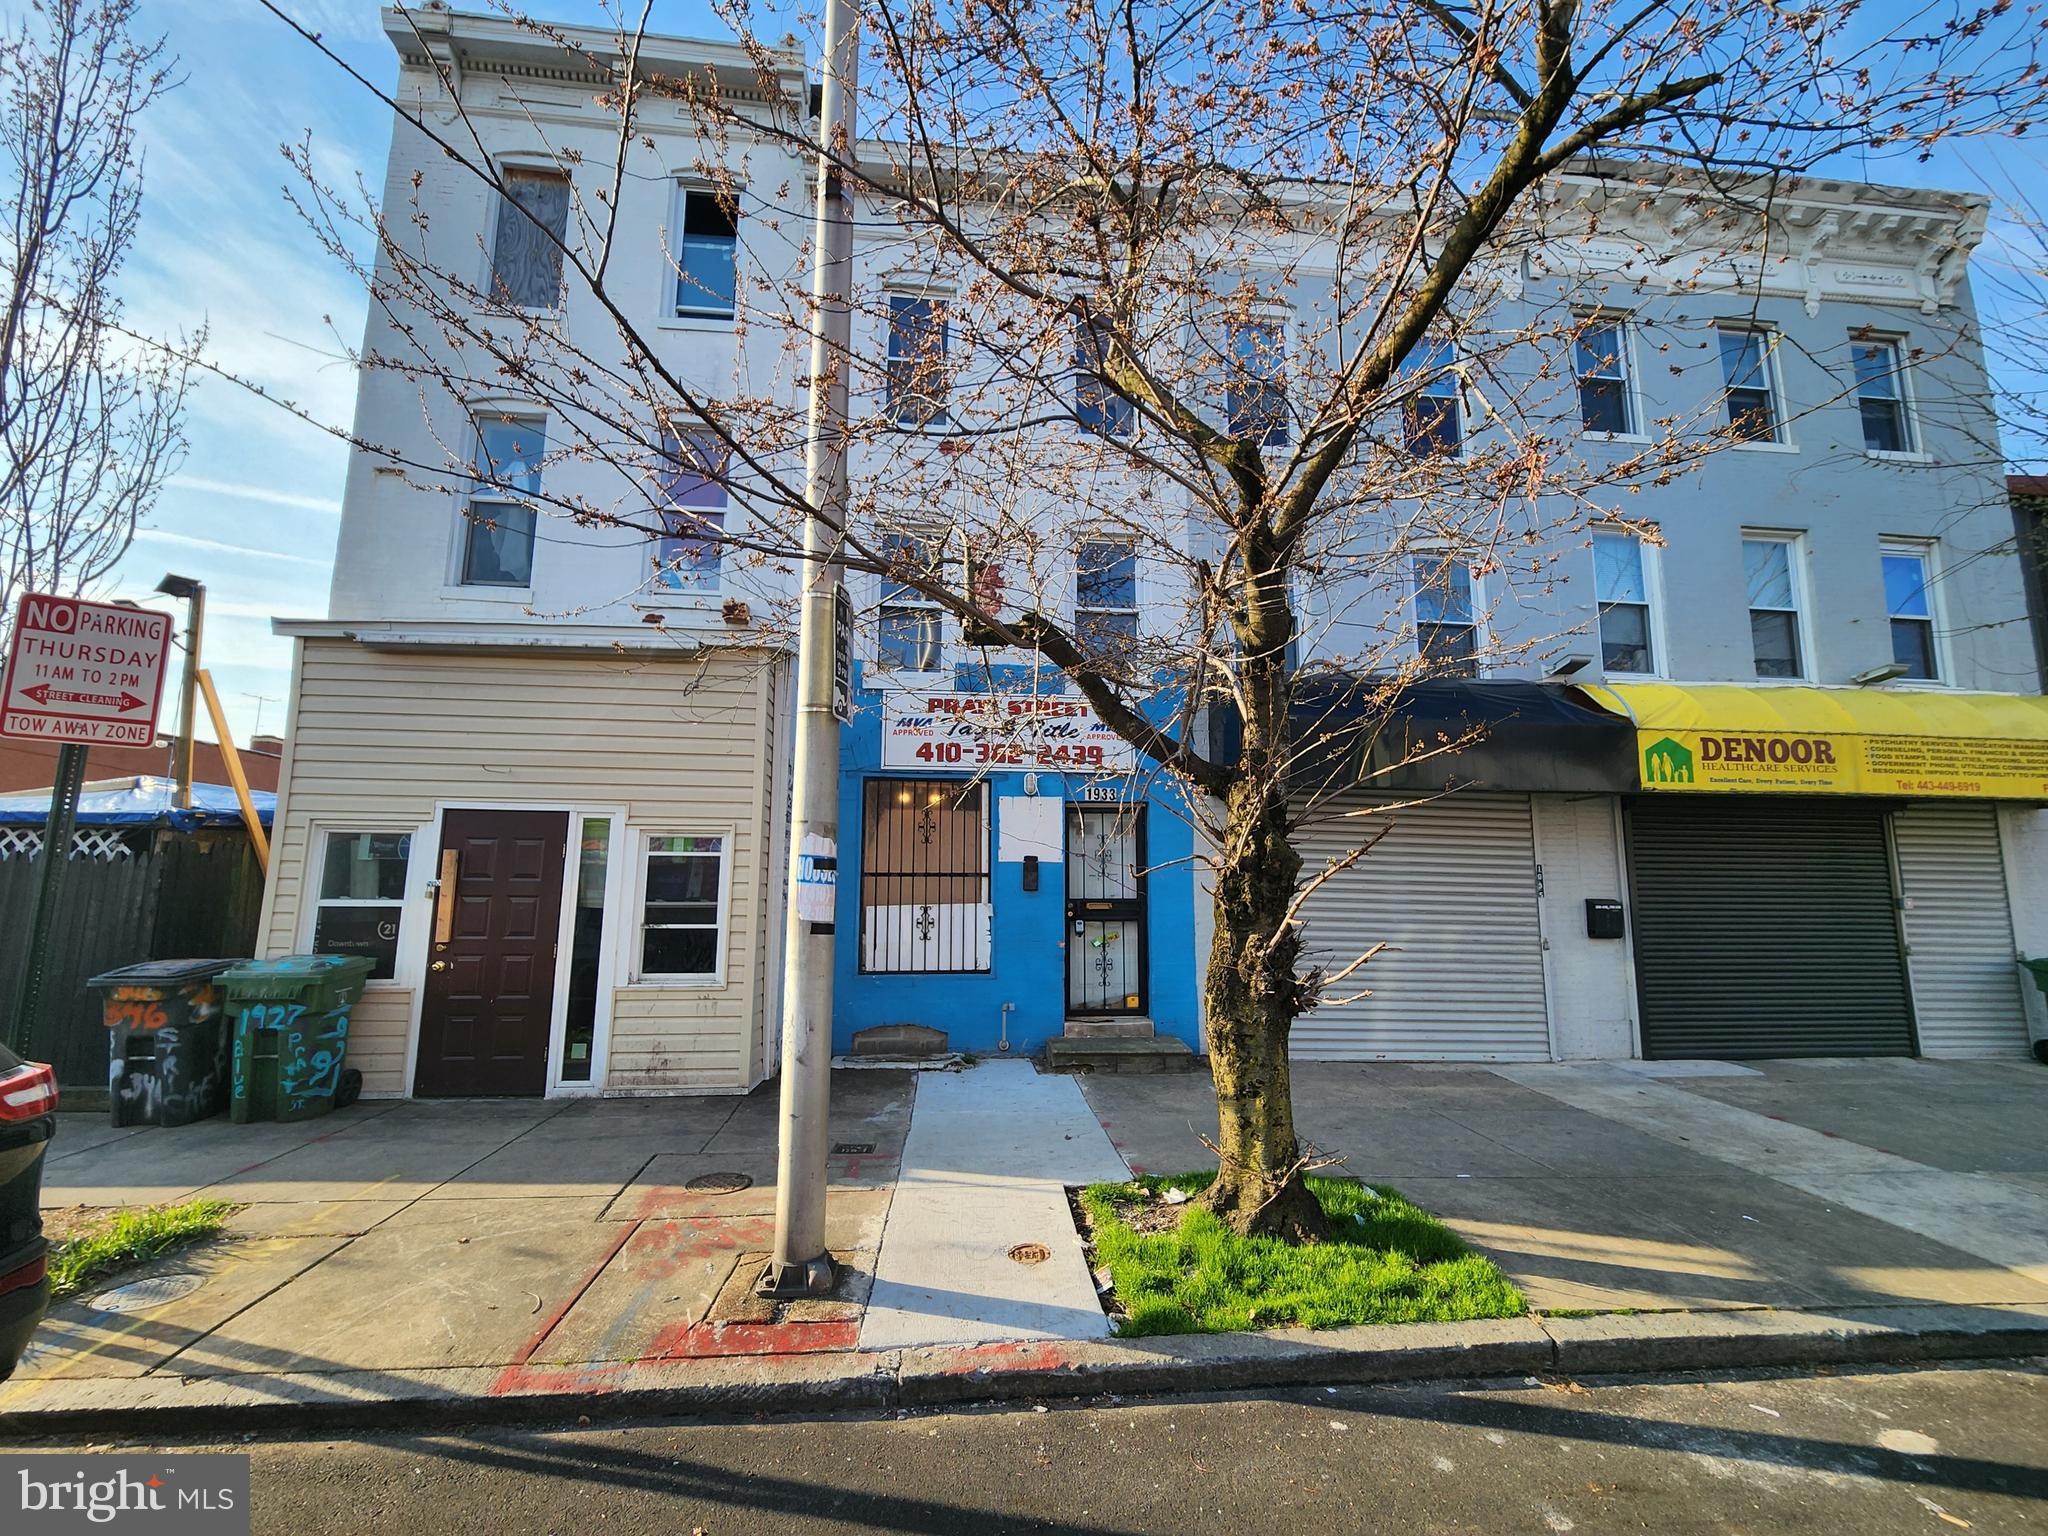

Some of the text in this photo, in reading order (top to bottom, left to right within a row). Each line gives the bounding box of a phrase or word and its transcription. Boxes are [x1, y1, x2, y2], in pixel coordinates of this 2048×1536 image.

[26, 600, 161, 640] NO PARKING
[24, 637, 158, 669] THURSDAY
[82, 669, 101, 684] TO
[36, 689, 130, 707] STREET CLEANING
[1008, 700, 1088, 717] STREET
[10, 716, 146, 740] TOW AWAY ZONE
[896, 718, 934, 728] MVA
[1700, 737, 1836, 764] DENOOR
[1702, 763, 1838, 774] HEALTHCARE SERVICES
[1896, 780, 1914, 790] Tel:
[1086, 788, 1116, 801] 1933
[328, 939, 369, 947] Downtwn
[240, 1003, 308, 1036] 1927
